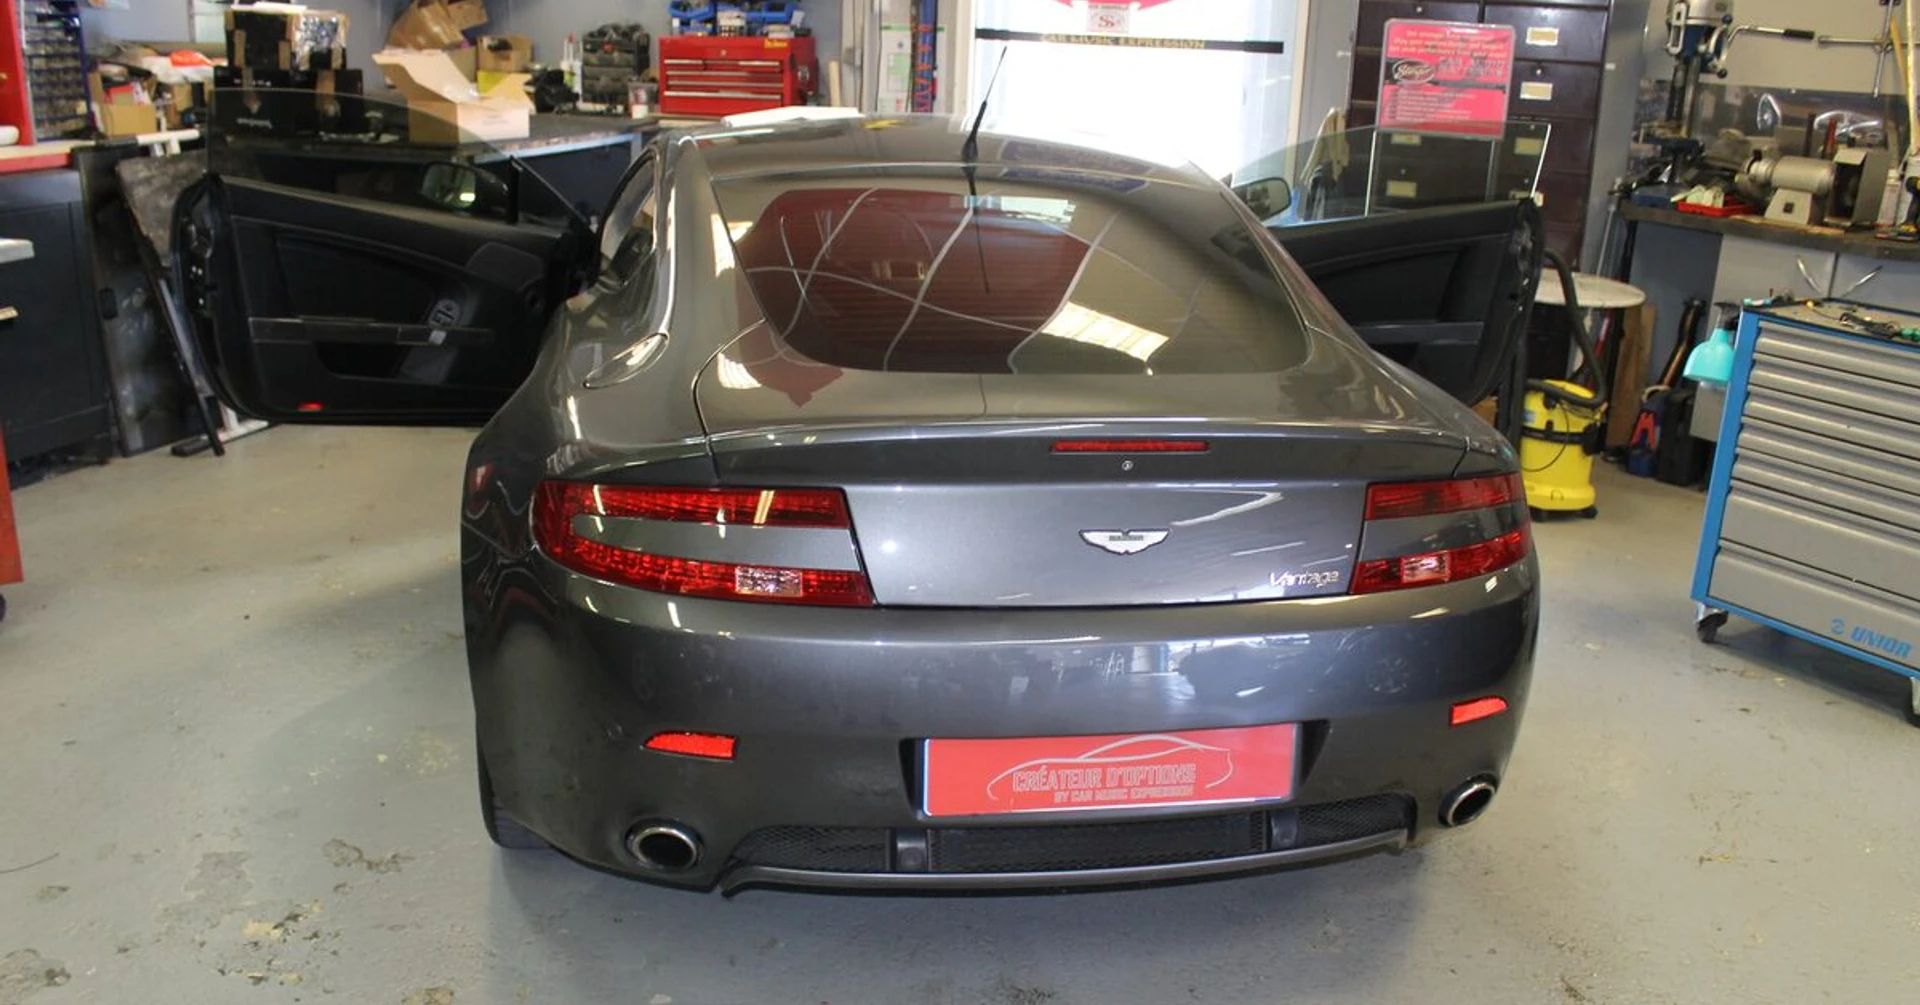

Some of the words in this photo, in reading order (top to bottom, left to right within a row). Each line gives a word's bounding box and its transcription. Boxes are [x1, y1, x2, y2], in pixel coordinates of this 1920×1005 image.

[1119, 36, 1205, 50] EXPRESSION
[1270, 571, 1339, 588] Vantage
[1850, 626, 1912, 659] UNIOR
